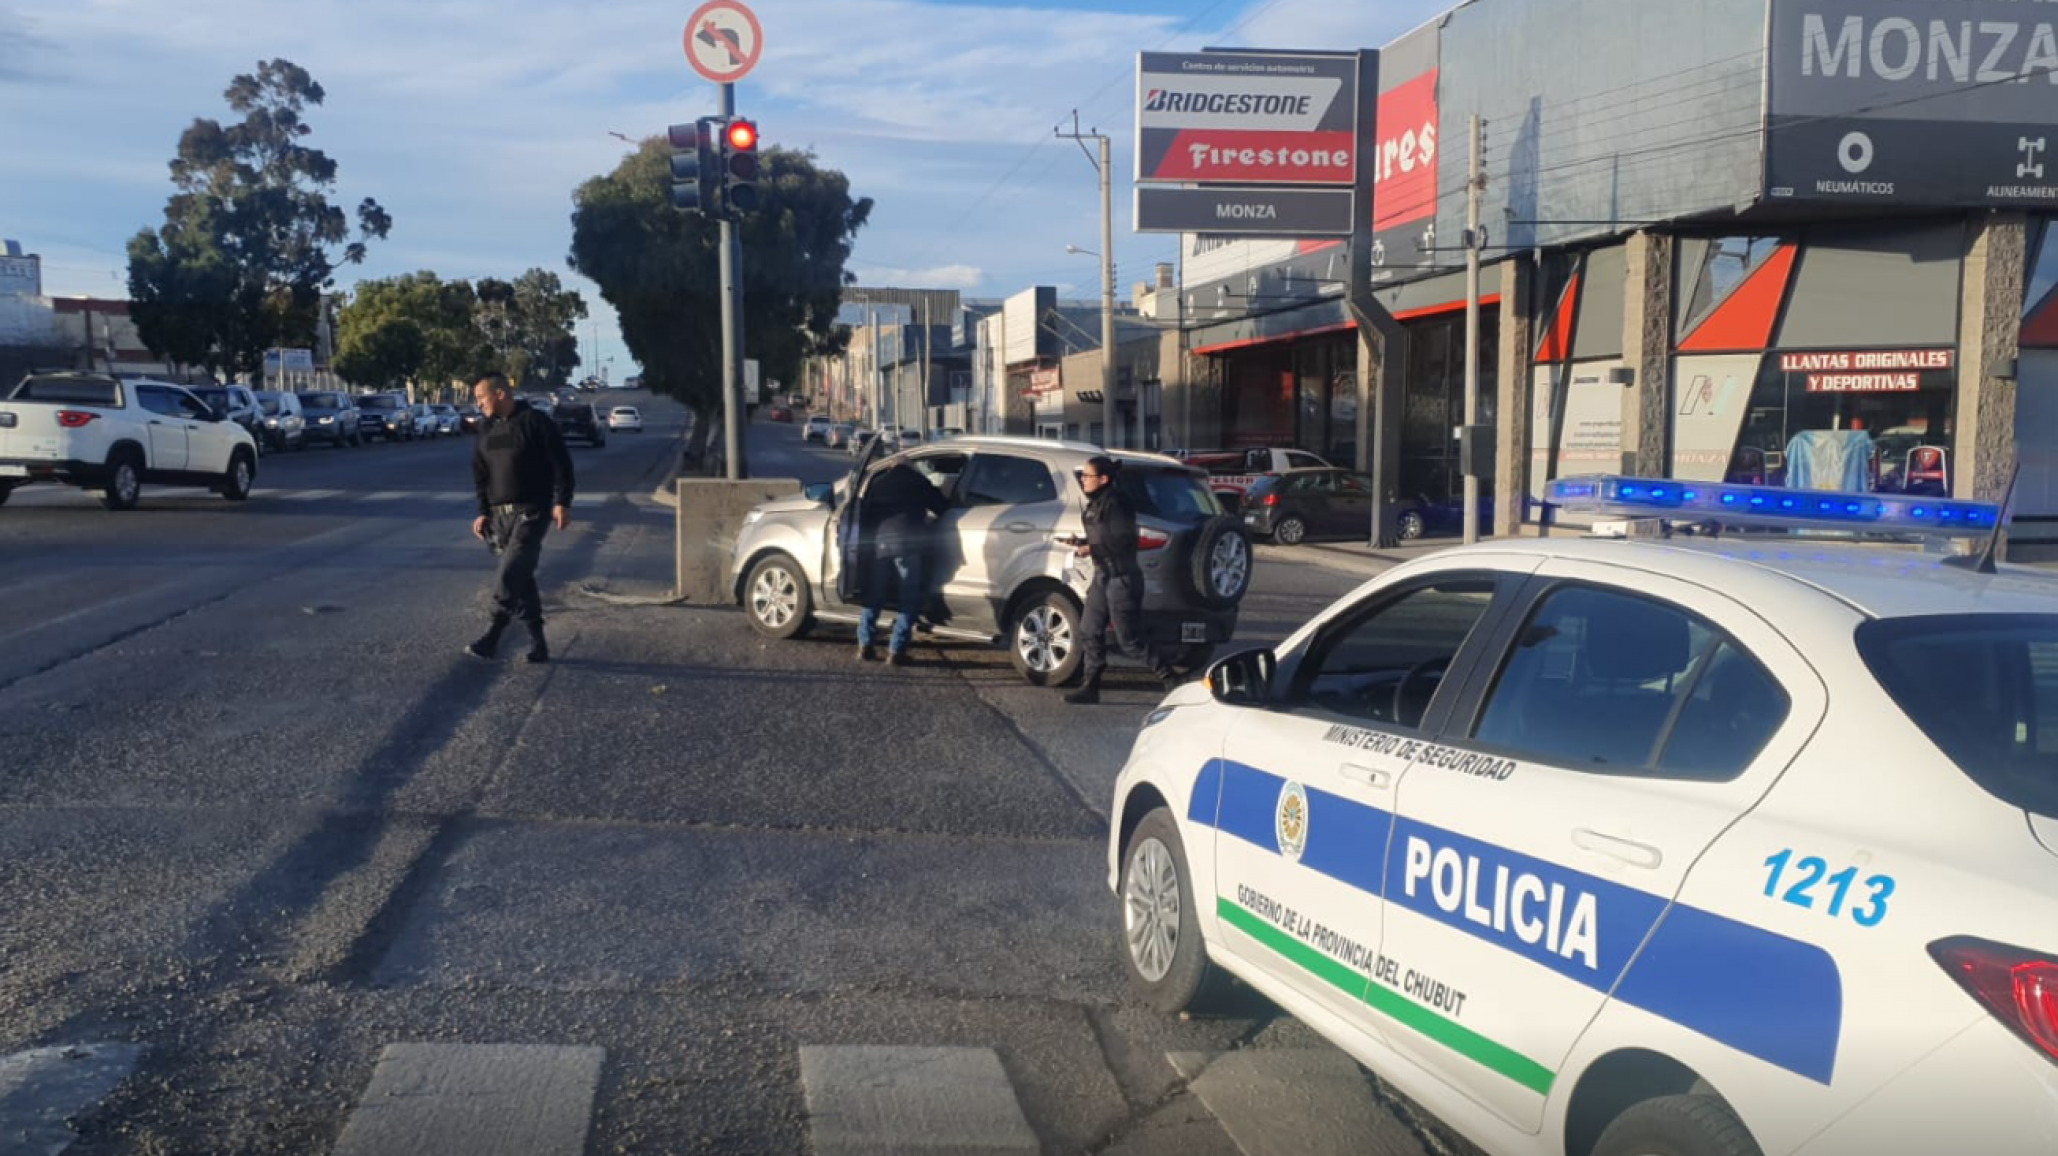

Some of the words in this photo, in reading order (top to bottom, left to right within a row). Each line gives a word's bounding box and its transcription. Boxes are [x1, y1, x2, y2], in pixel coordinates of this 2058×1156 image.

[1801, 14, 2058, 85] MONZA
[1182, 61, 1212, 70] Centro
[1214, 62, 1226, 71] de
[1227, 62, 1265, 72] servicios
[1144, 89, 1311, 116] BRIDGESTONE
[1188, 143, 1350, 169] Firestone
[1816, 180, 1895, 195] NEUMÁTICOS
[1215, 203, 1277, 219] MONZA
[1783, 354, 1849, 370] LLANTAS
[1855, 351, 1948, 368] ORIGINALES
[1808, 376, 1820, 391] Y
[1822, 374, 1917, 391] DEPORTIVAS
[1323, 724, 1397, 754] MINISTERIO
[1395, 740, 1422, 760] DE
[1418, 744, 1516, 781] SEGURIDAD
[1763, 847, 1896, 927] 1213
[1404, 835, 1599, 970] POLICIA
[1238, 883, 1282, 927] GOBIERNO
[1283, 906, 1298, 932] DE
[1297, 917, 1311, 943] LA
[1312, 923, 1374, 971] PROVINCIA
[1375, 953, 1400, 987] DEL
[1404, 969, 1467, 1016] CHUBUT
